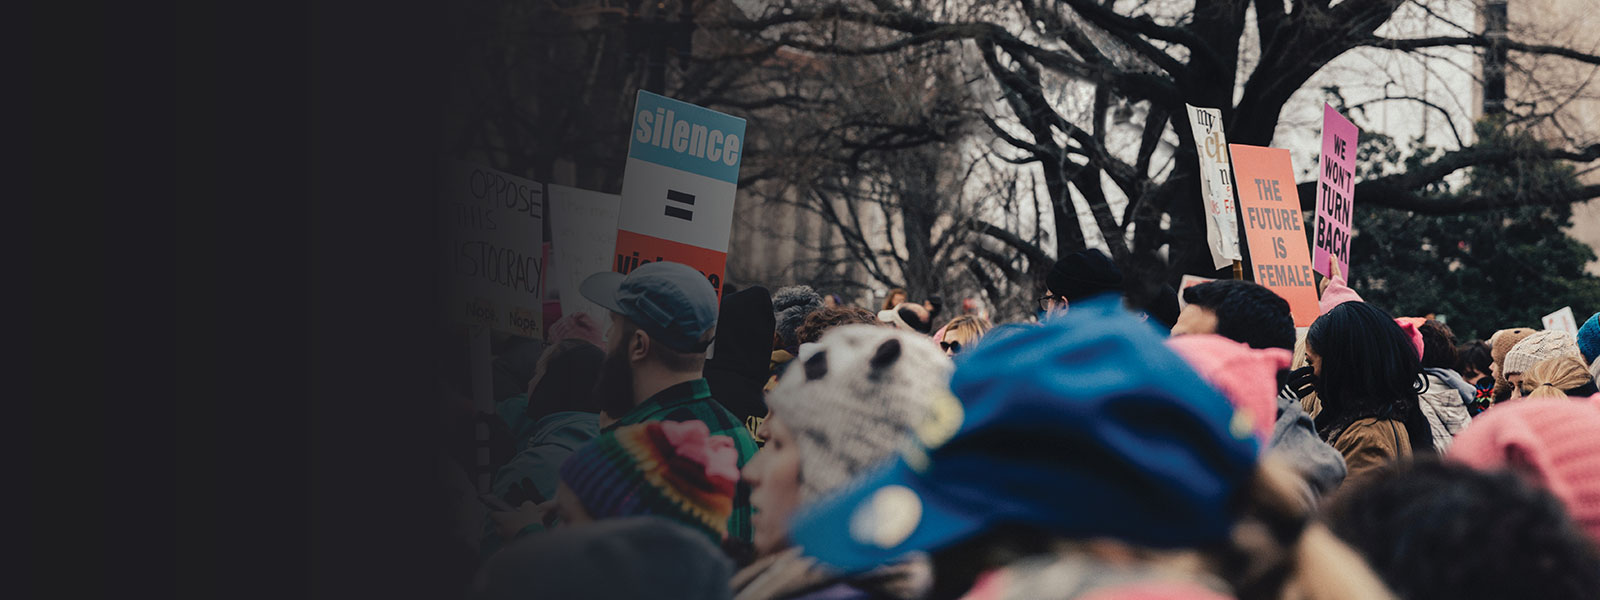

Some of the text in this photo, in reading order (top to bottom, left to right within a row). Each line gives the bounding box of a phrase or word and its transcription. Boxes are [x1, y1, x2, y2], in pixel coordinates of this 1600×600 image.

[636, 107, 740, 167] silence
[1334, 134, 1347, 161] WE
[1325, 155, 1351, 194] WON'T
[471, 168, 543, 219] OPPOSE
[1254, 178, 1282, 202] THE
[1322, 181, 1350, 228] TURN
[1247, 207, 1301, 231] FUTURE
[1272, 236, 1288, 259] IS
[1317, 215, 1349, 265] BACK
[1257, 264, 1313, 287] FEMALE
[509, 311, 539, 333] Nope.
